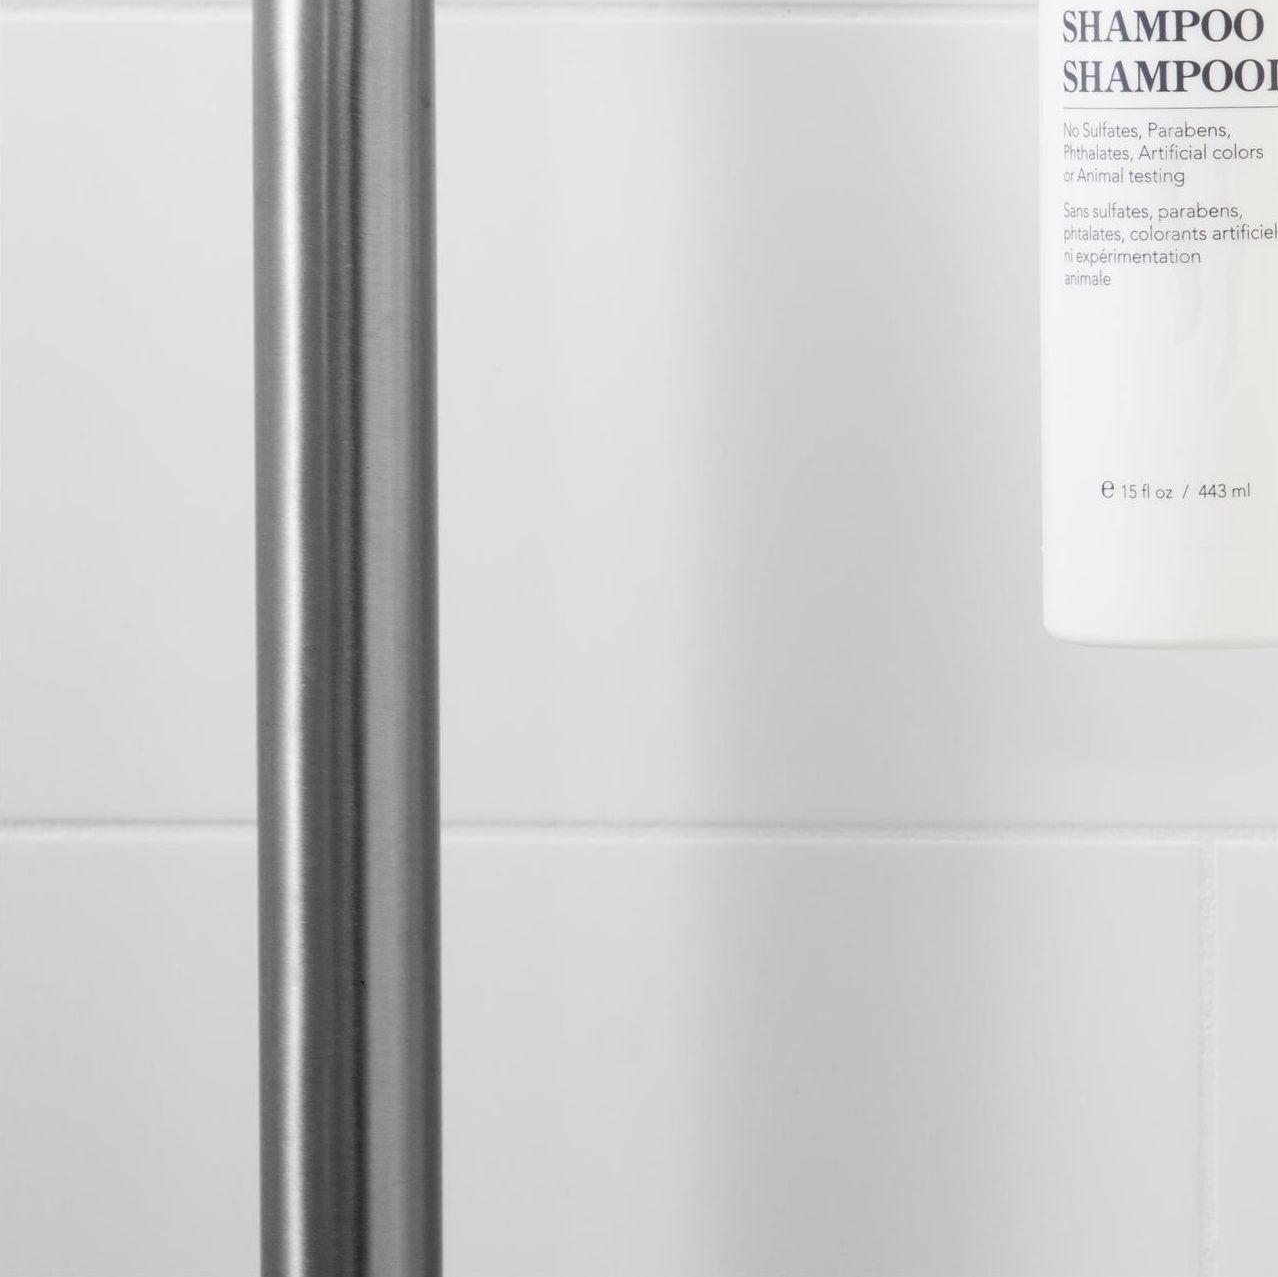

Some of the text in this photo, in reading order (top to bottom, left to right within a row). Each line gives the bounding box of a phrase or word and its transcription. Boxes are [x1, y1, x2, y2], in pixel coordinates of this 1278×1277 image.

[1063, 9, 1264, 43] SHAMPOO
[1064, 122, 1231, 139] No Sulfates, Parabens,
[1064, 144, 1264, 162] Phthalates, Artificial colors
[1064, 168, 1185, 186] or Animal testing
[1064, 202, 1243, 222] Sans sulfates, parabens,
[1064, 226, 1124, 243] phtalates,
[1130, 226, 1207, 241] colorants
[1064, 249, 1201, 267] ni expérimentation
[1064, 271, 1112, 287] animale
[1121, 484, 1137, 499] 15
[1142, 484, 1150, 499] fl
[1156, 487, 1173, 500] oz
[1198, 484, 1227, 498] 443
[1232, 482, 1250, 498] ml
